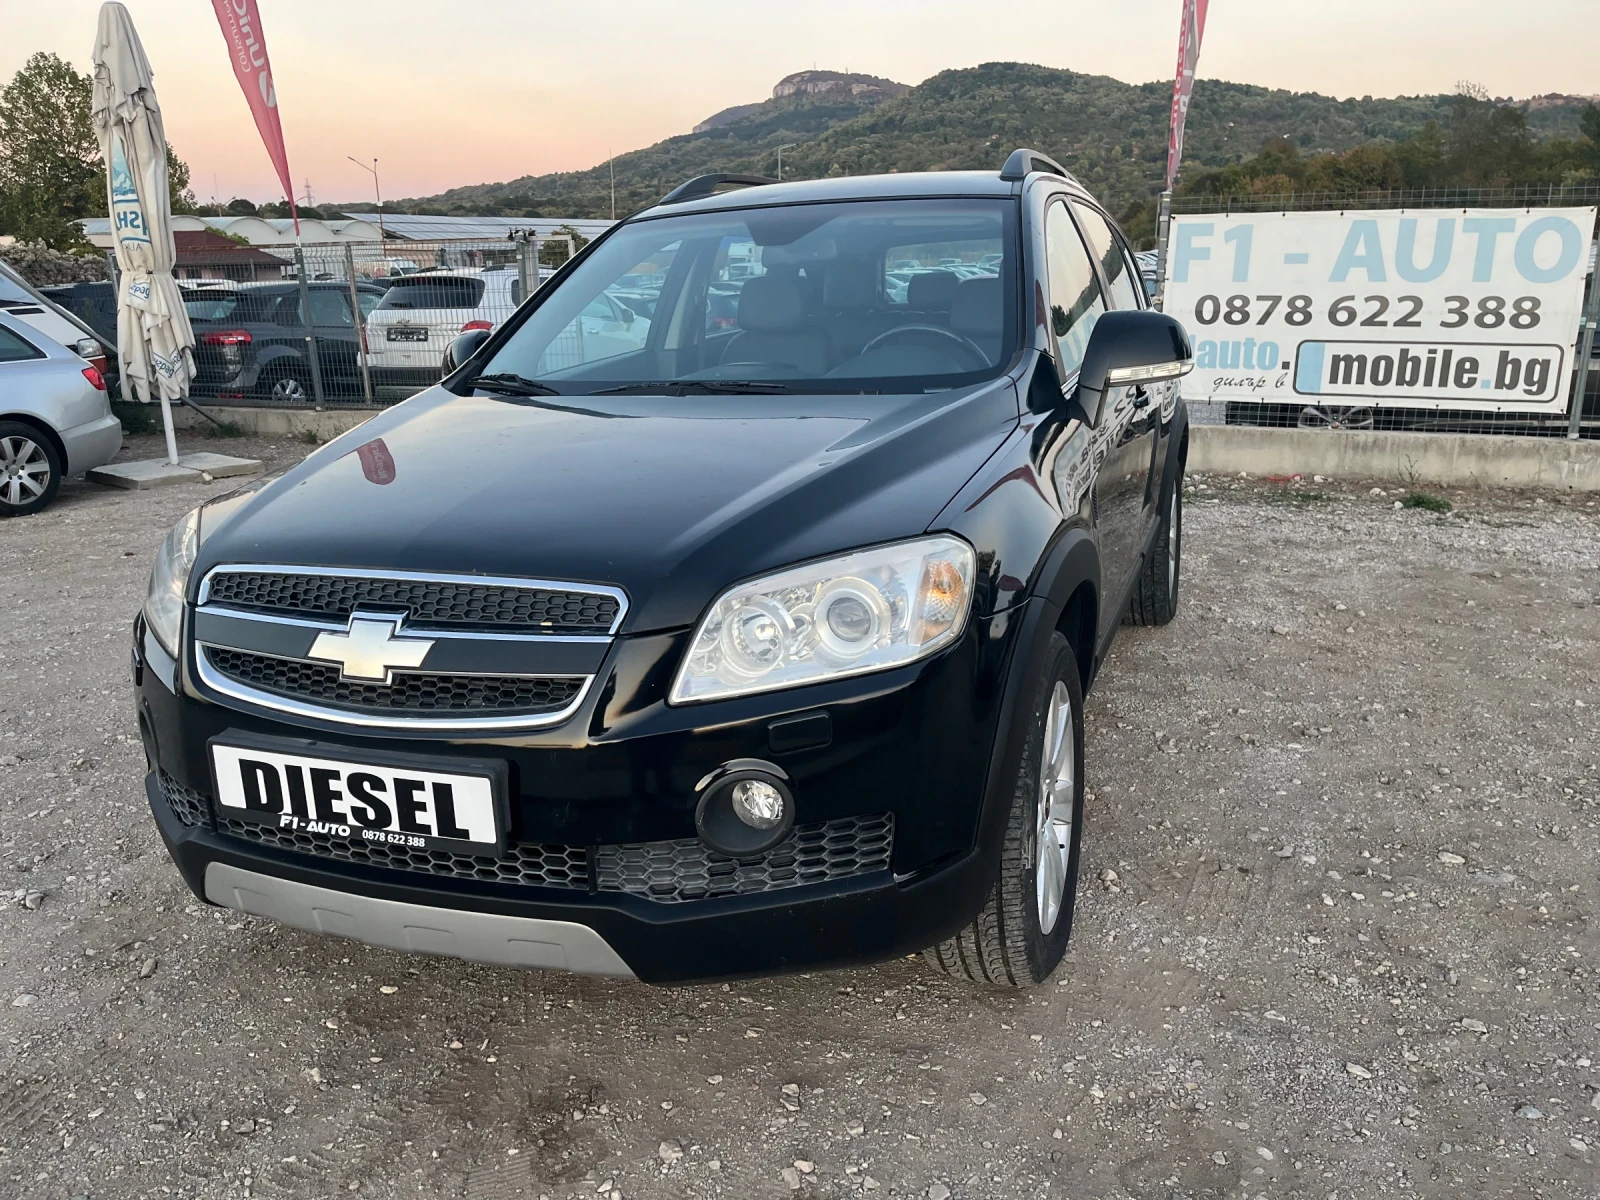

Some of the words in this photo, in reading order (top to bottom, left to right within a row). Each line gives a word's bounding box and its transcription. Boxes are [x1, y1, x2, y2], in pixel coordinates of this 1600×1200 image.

[1172, 222, 1254, 283] F1
[1328, 216, 1583, 284] AUTO
[1194, 294, 1313, 327] 0878
[1327, 294, 1424, 328] 622
[1439, 295, 1542, 330] 388
[1328, 347, 1552, 396] mobile.bg
[238, 758, 471, 841] DIESEL
[279, 813, 351, 837] F1-AUTO
[362, 829, 386, 843] 0878
[387, 833, 406, 846] 622
[406, 835, 426, 848] 388
